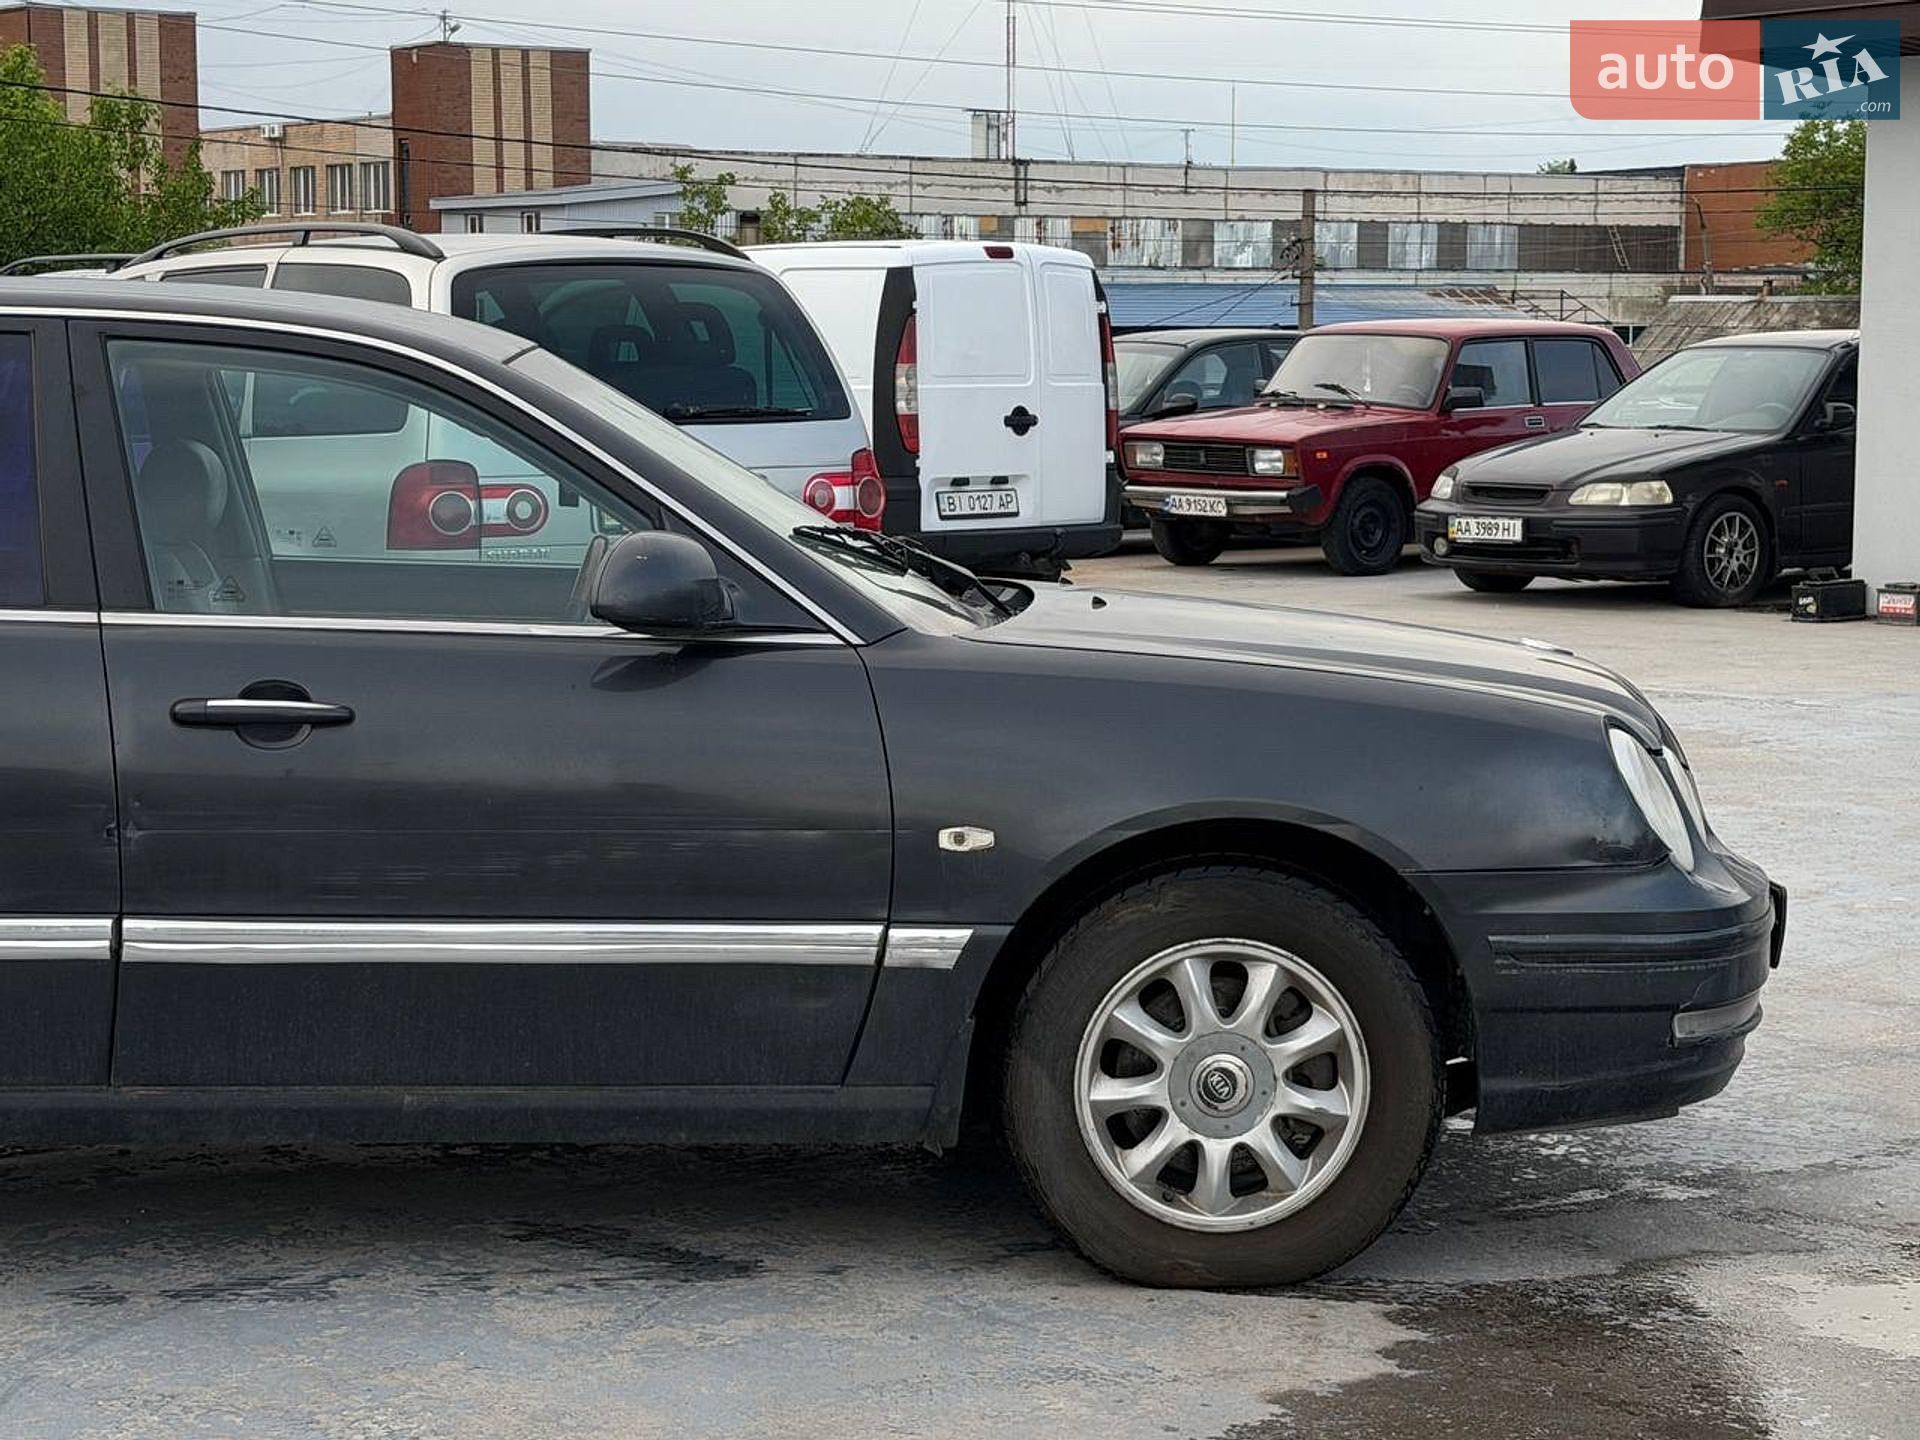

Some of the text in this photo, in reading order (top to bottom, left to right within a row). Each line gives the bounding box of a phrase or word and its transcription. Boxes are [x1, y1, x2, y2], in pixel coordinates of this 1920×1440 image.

[968, 494, 993, 511] 0127
[998, 493, 1013, 509] AP
[1456, 521, 1471, 535] AA
[1475, 521, 1499, 536] 3989
[1210, 1073, 1230, 1097] KIA
